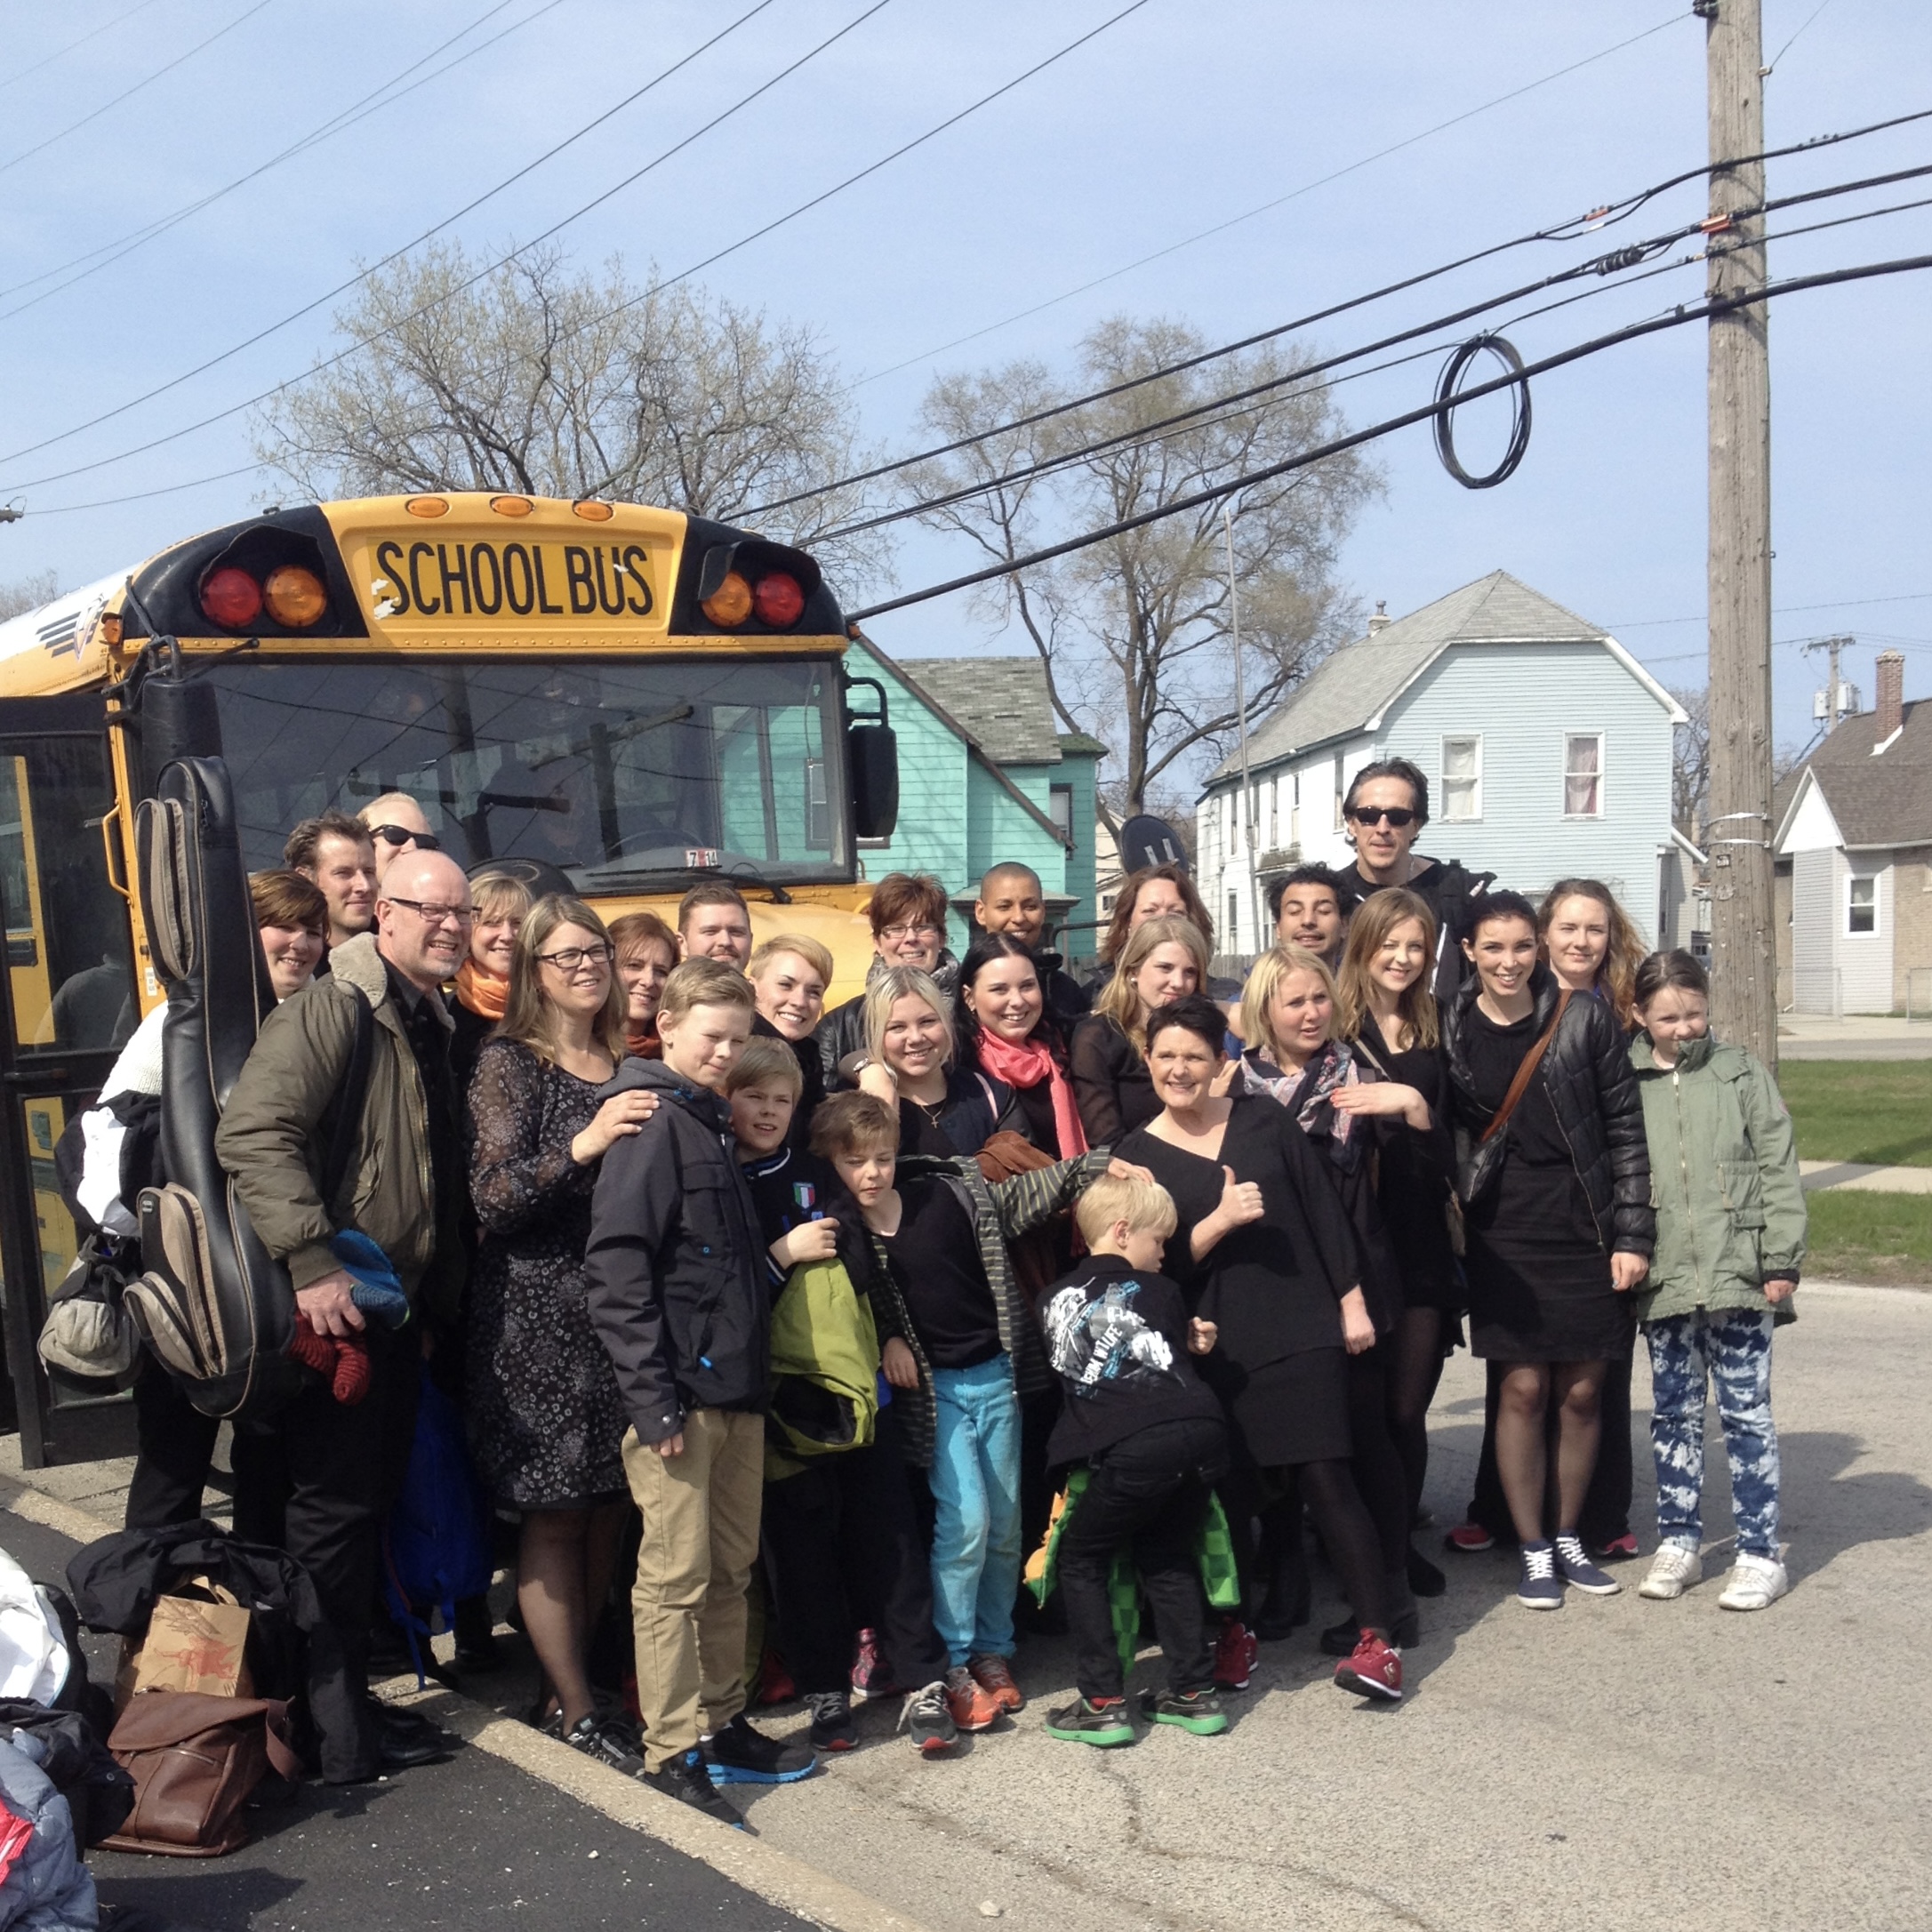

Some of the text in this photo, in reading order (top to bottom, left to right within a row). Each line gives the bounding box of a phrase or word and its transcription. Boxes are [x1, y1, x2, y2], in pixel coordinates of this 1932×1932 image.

[376, 541, 653, 615] SCHOOL BUS
[689, 851, 697, 867] 7
